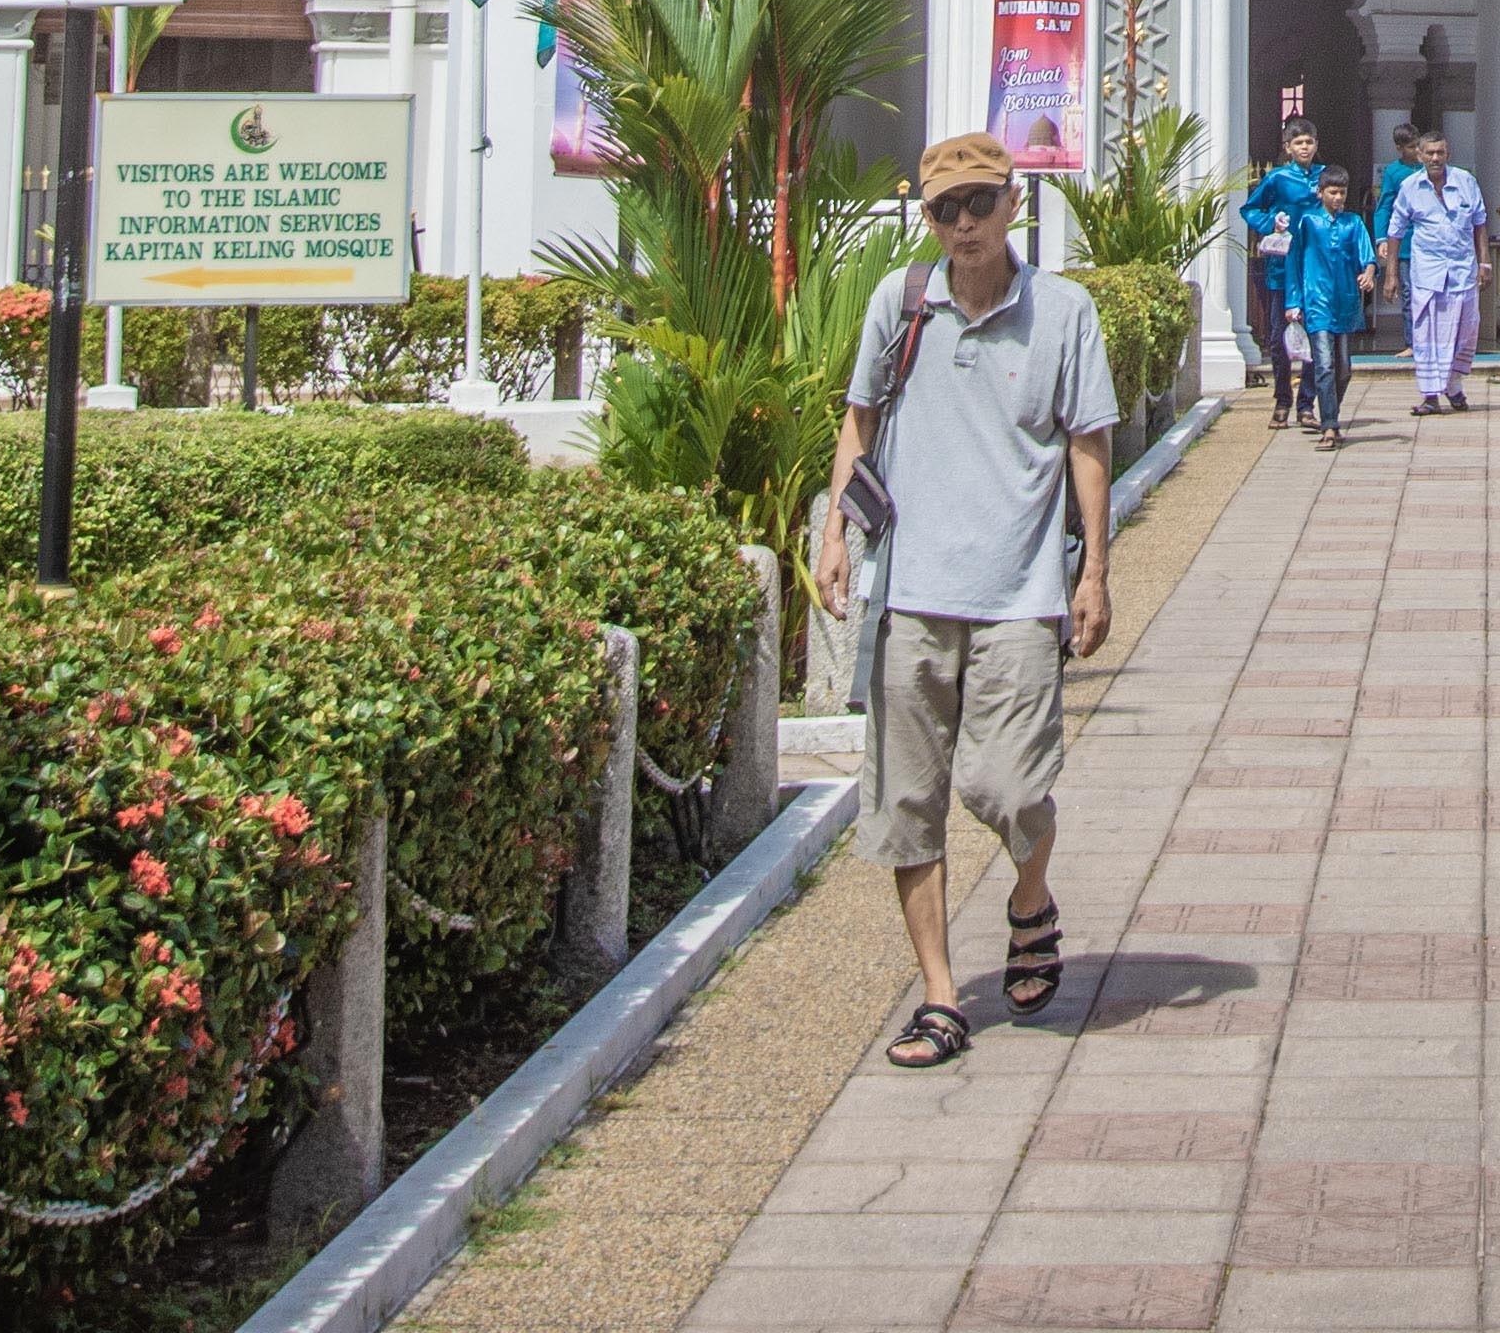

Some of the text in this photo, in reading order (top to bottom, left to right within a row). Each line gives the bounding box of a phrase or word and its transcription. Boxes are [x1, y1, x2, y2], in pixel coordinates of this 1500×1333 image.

[998, 0, 1080, 17] MUHAMMAD
[1035, 19, 1073, 32] S.A.W
[998, 46, 1031, 72] Jom
[1002, 63, 1063, 88] Selawat
[1003, 91, 1074, 113] Bersama
[117, 162, 387, 183] VISITORS ARE WELCOME
[163, 188, 341, 208] TO THE ISLAMIC
[119, 213, 381, 234] INFORMATION SERVICES
[105, 239, 394, 261] KAPITAN KELING MOSQUE
